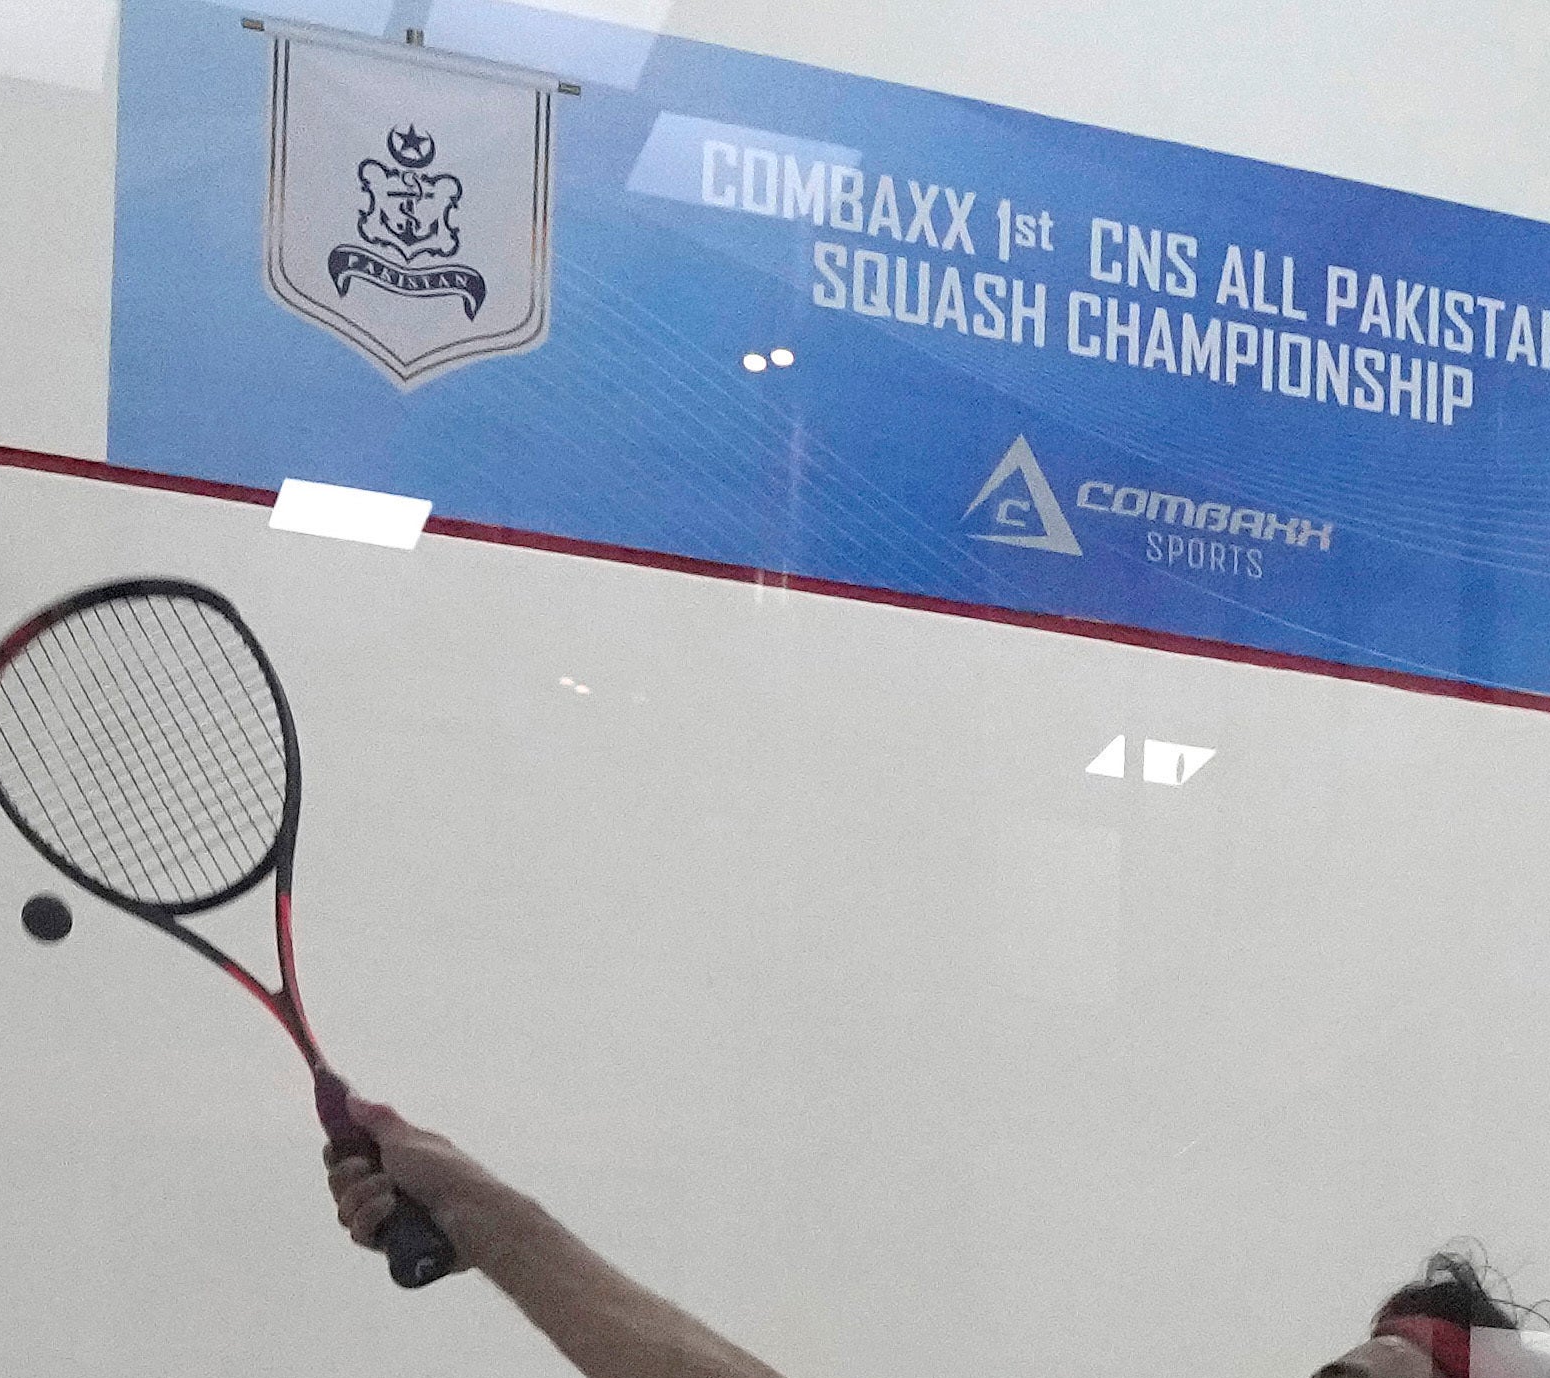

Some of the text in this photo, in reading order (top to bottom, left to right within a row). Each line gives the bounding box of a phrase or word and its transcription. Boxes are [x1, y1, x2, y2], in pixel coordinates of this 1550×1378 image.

[701, 141, 975, 254] COMBAXX
[997, 198, 1054, 263] 1st
[1090, 217, 1196, 299] CNS
[1216, 245, 1307, 321] ALL
[812, 242, 1475, 425] SQUASH CHAMPIONSHIP
[1077, 480, 1335, 551] COMBAXX
[1147, 531, 1264, 579] SPORTS
